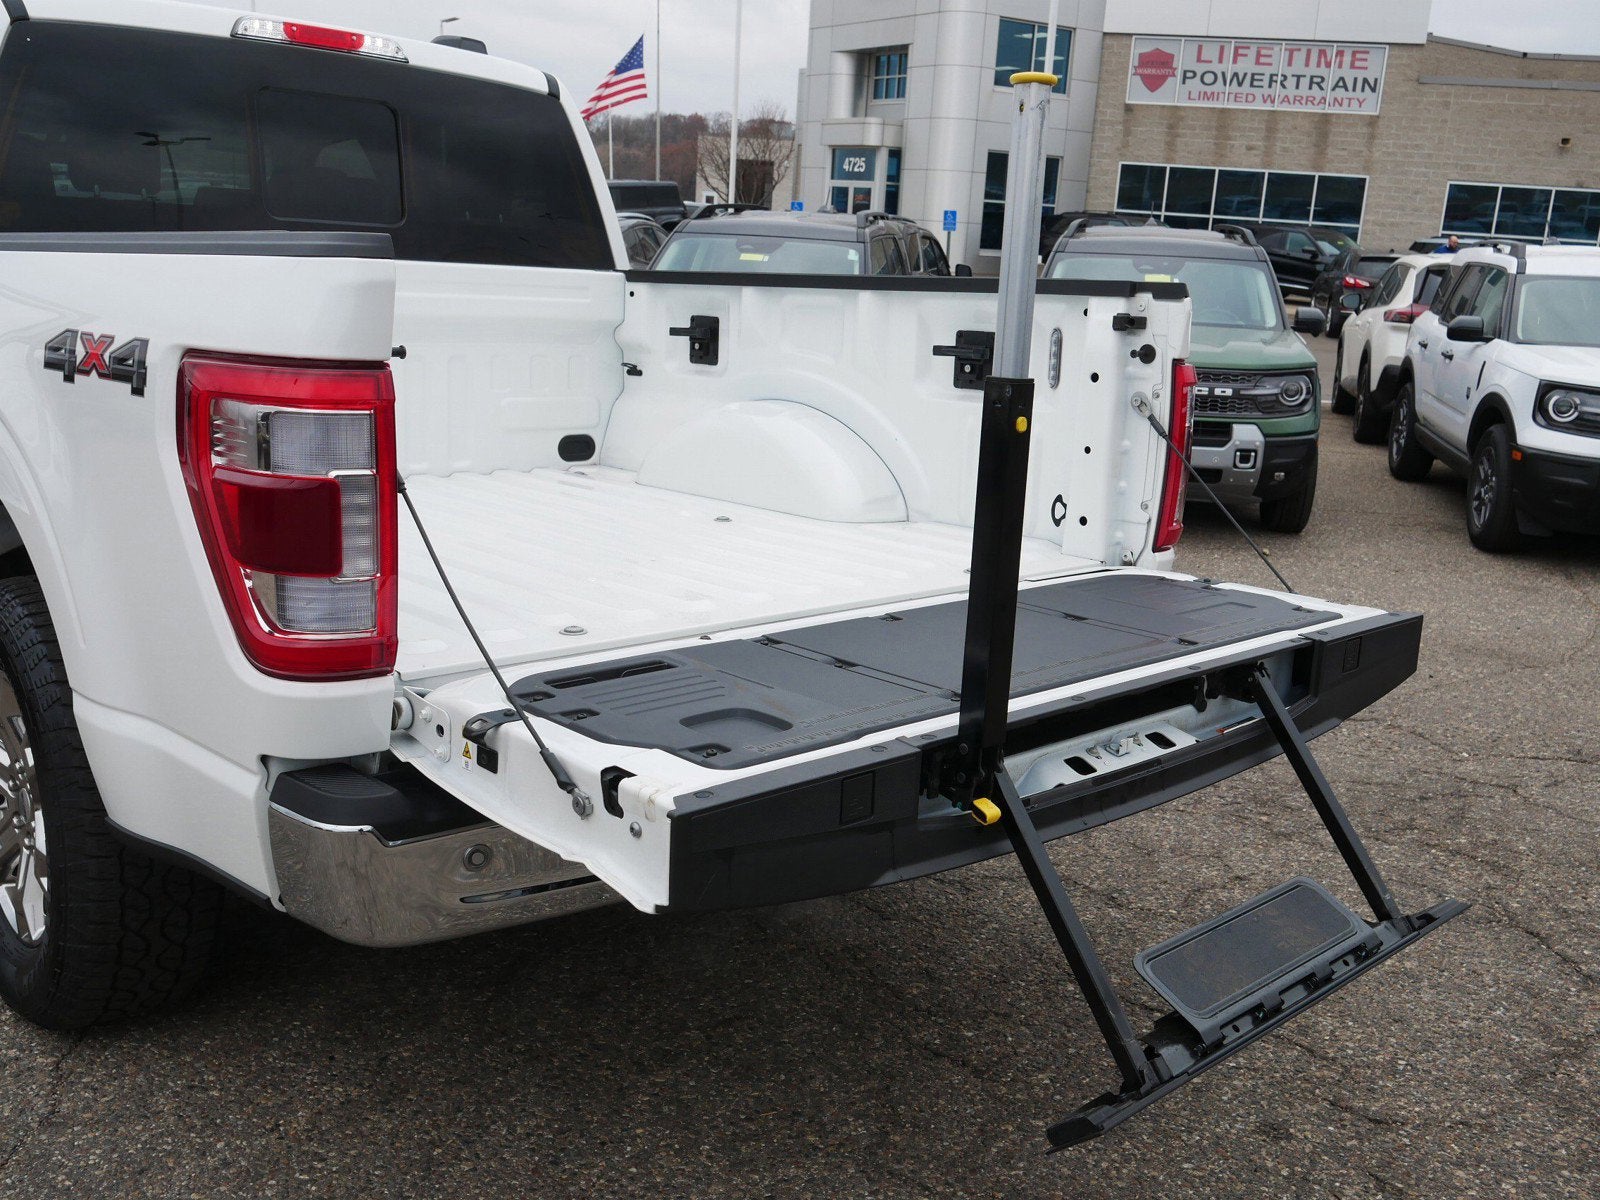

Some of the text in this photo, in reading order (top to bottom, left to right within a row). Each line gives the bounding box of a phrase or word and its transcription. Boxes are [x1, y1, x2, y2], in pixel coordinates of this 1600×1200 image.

[1196, 44, 1370, 70] LIFETIME
[1136, 67, 1174, 76] WARRANTY
[1181, 69, 1378, 93] POWERTRAIN
[1188, 90, 1367, 108] LIMITED WARRANTY
[842, 157, 866, 172] 4725
